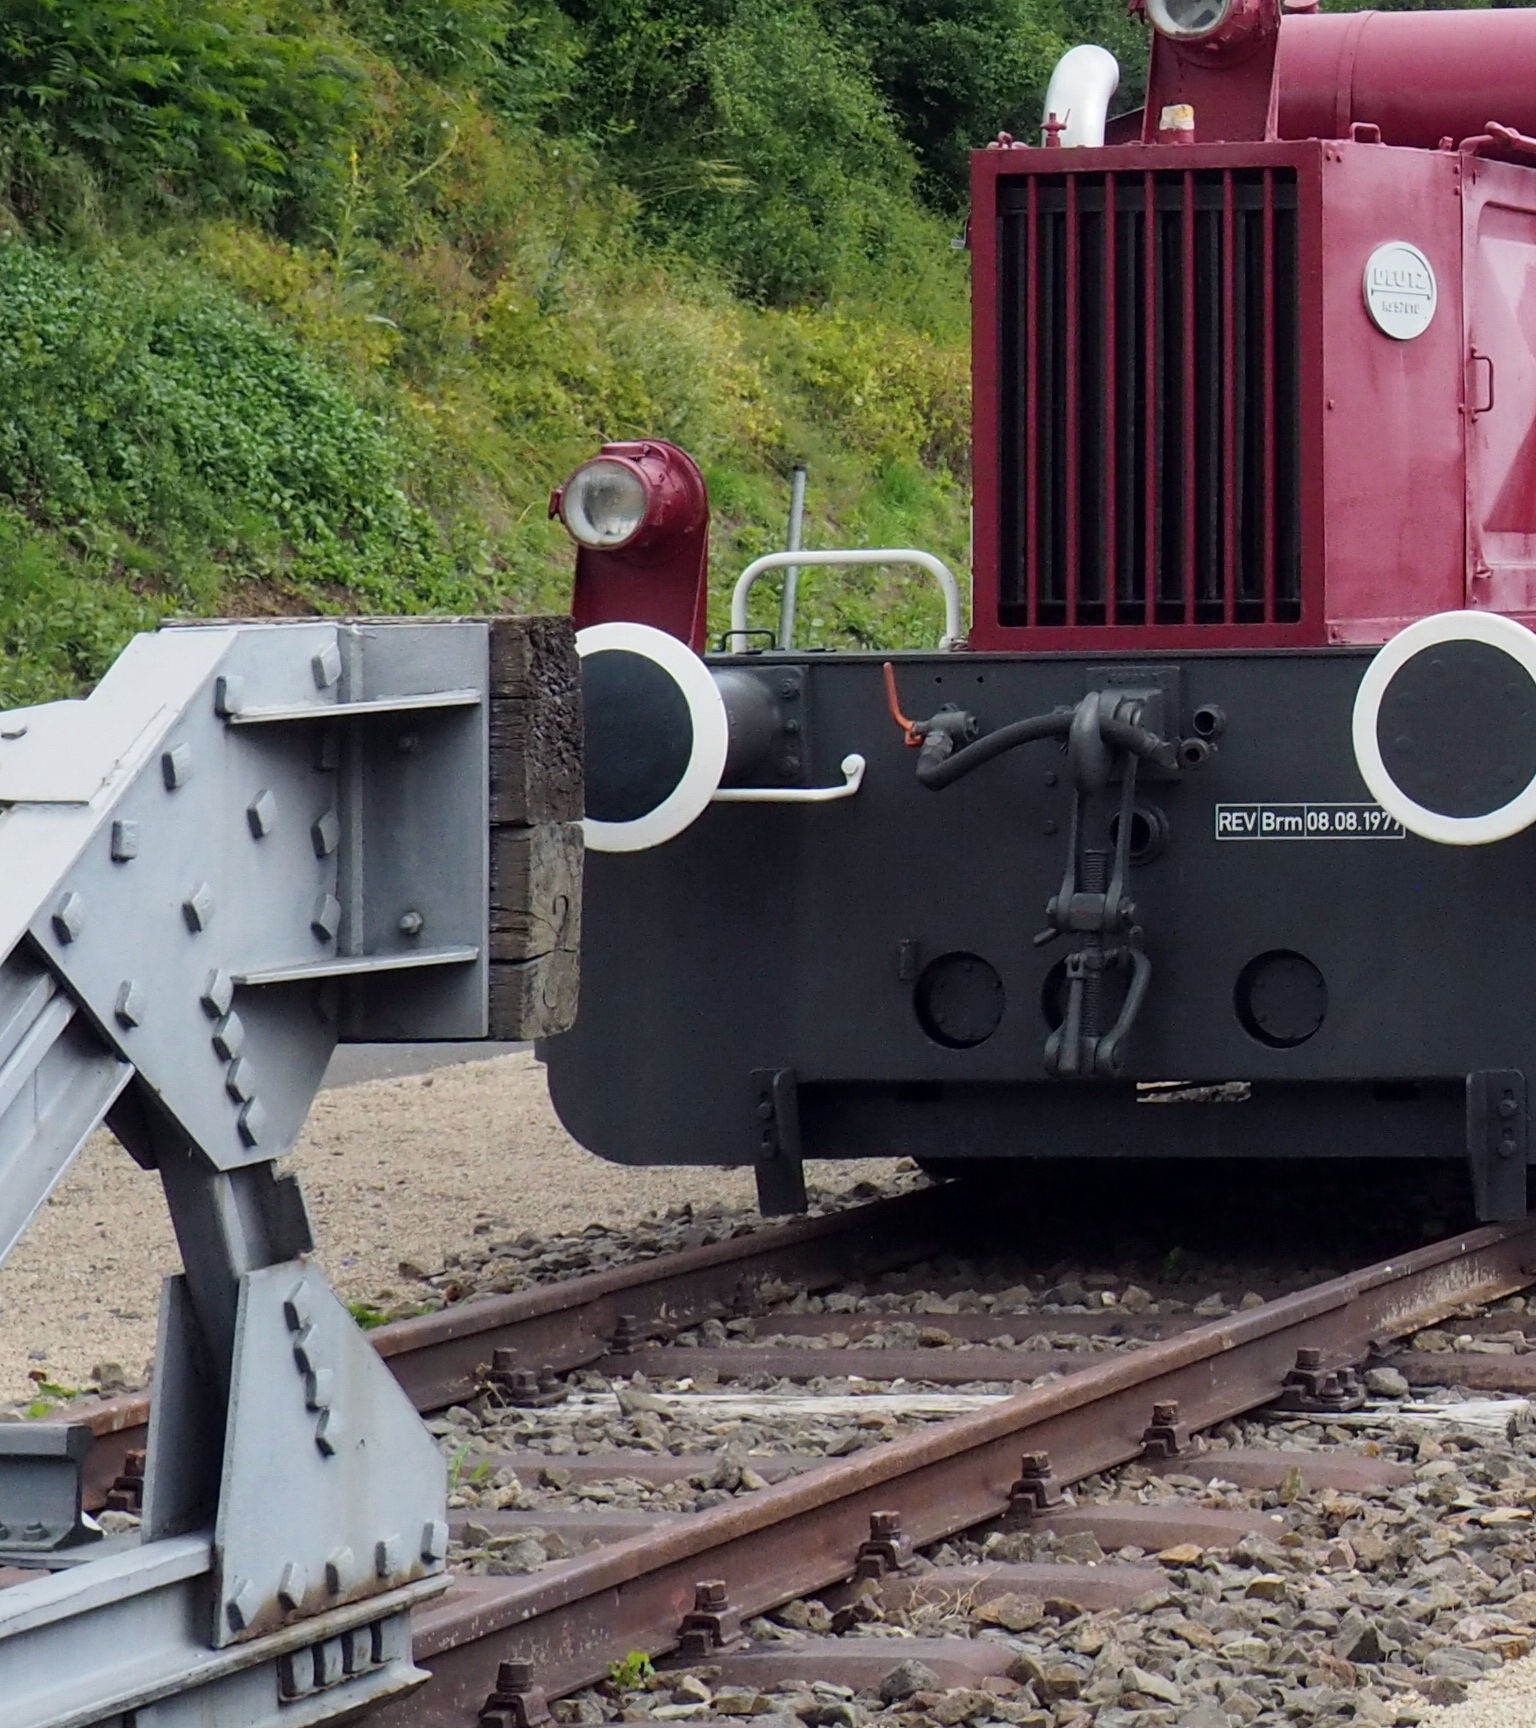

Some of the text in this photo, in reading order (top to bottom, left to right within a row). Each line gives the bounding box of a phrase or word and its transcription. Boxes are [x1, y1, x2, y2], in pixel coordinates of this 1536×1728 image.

[1373, 267, 1427, 290] DEUTZ
[1218, 812, 1257, 831] REV
[1261, 812, 1303, 831] Brm
